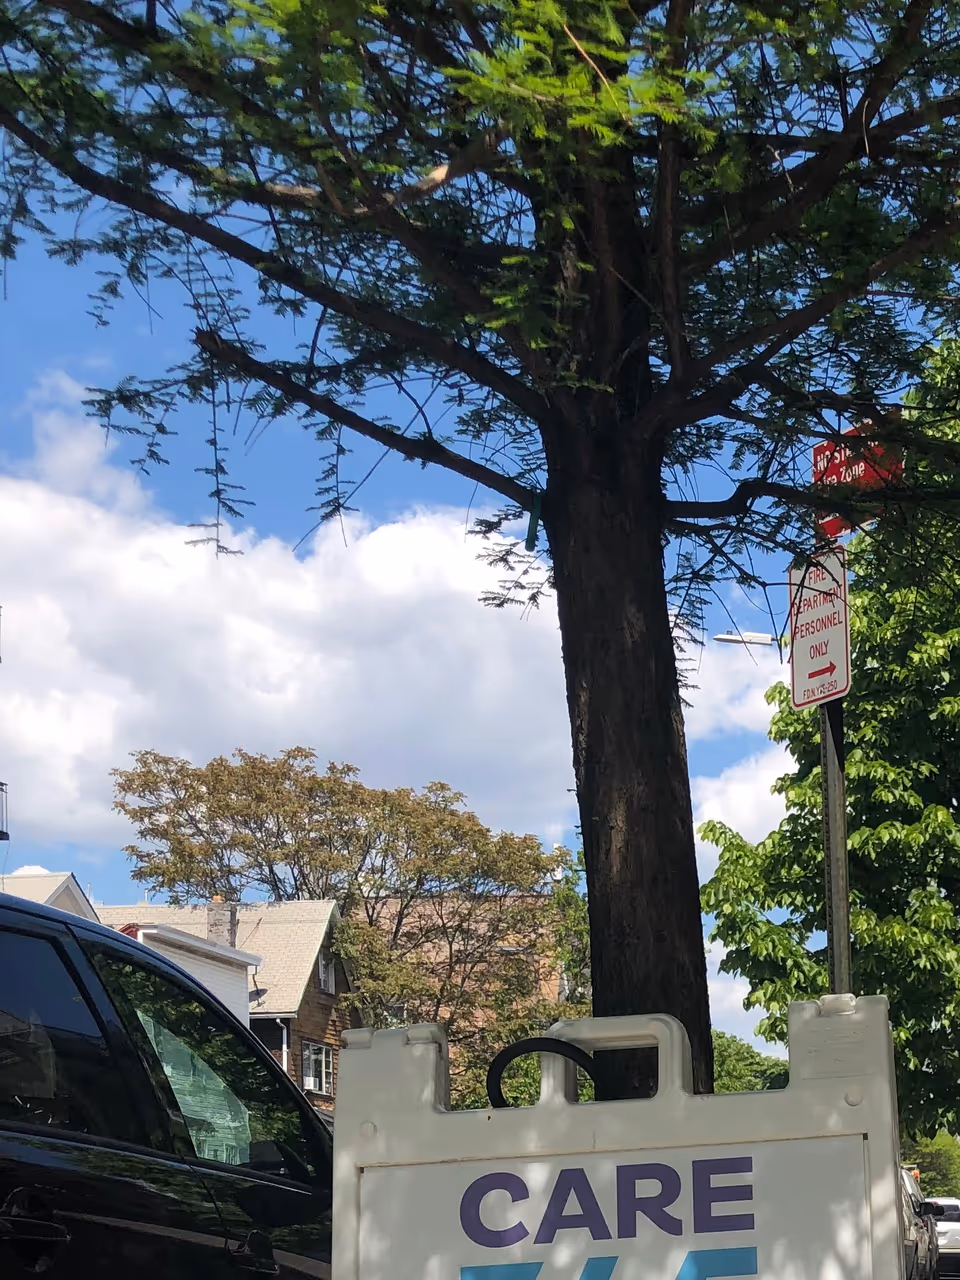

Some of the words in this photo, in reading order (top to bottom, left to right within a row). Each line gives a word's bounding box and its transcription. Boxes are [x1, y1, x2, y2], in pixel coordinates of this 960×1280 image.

[840, 462, 866, 483] Zone
[808, 567, 827, 586] FIRE
[792, 583, 843, 617] DEPARTMENT
[794, 610, 843, 640] PERSONNEL
[809, 639, 829, 660] ONLY
[460, 1156, 755, 1248] CARE
